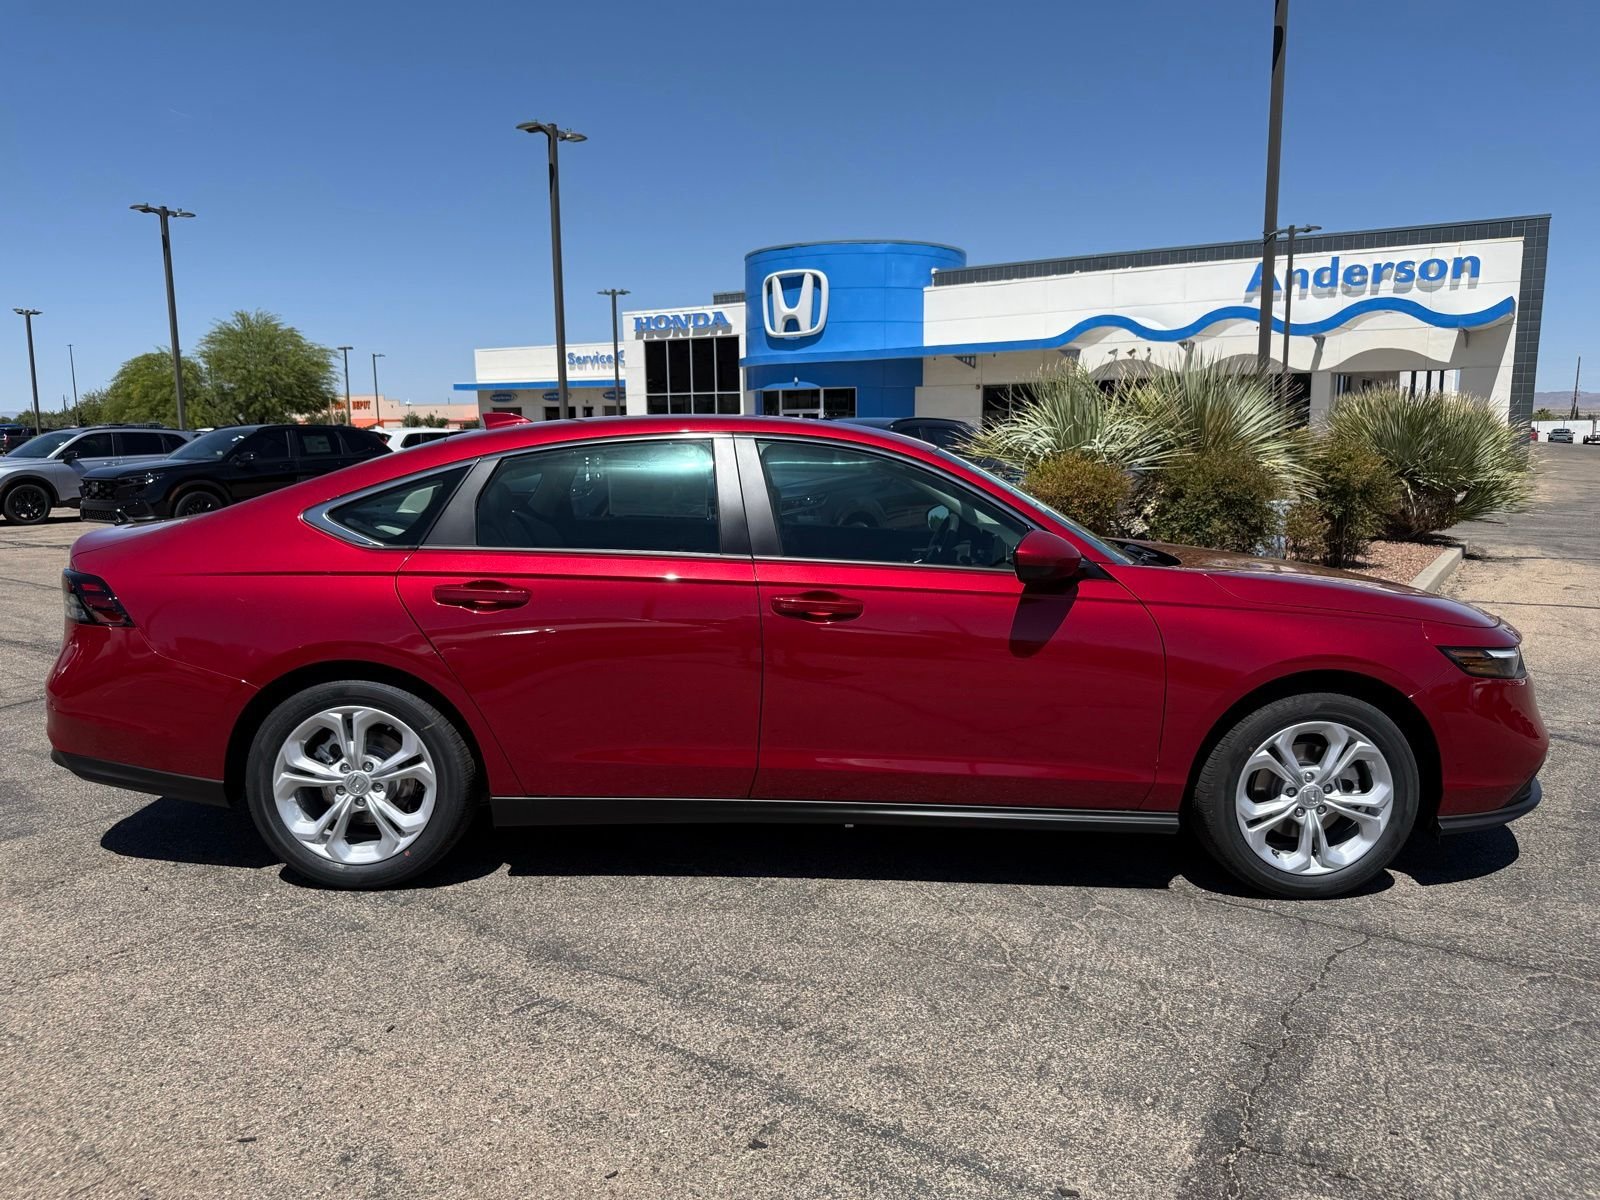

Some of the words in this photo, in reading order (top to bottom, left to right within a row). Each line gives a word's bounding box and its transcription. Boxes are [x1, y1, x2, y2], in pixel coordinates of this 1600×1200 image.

[1245, 255, 1481, 292] Anderson
[633, 311, 730, 332] HONDA
[567, 351, 614, 365] Service
